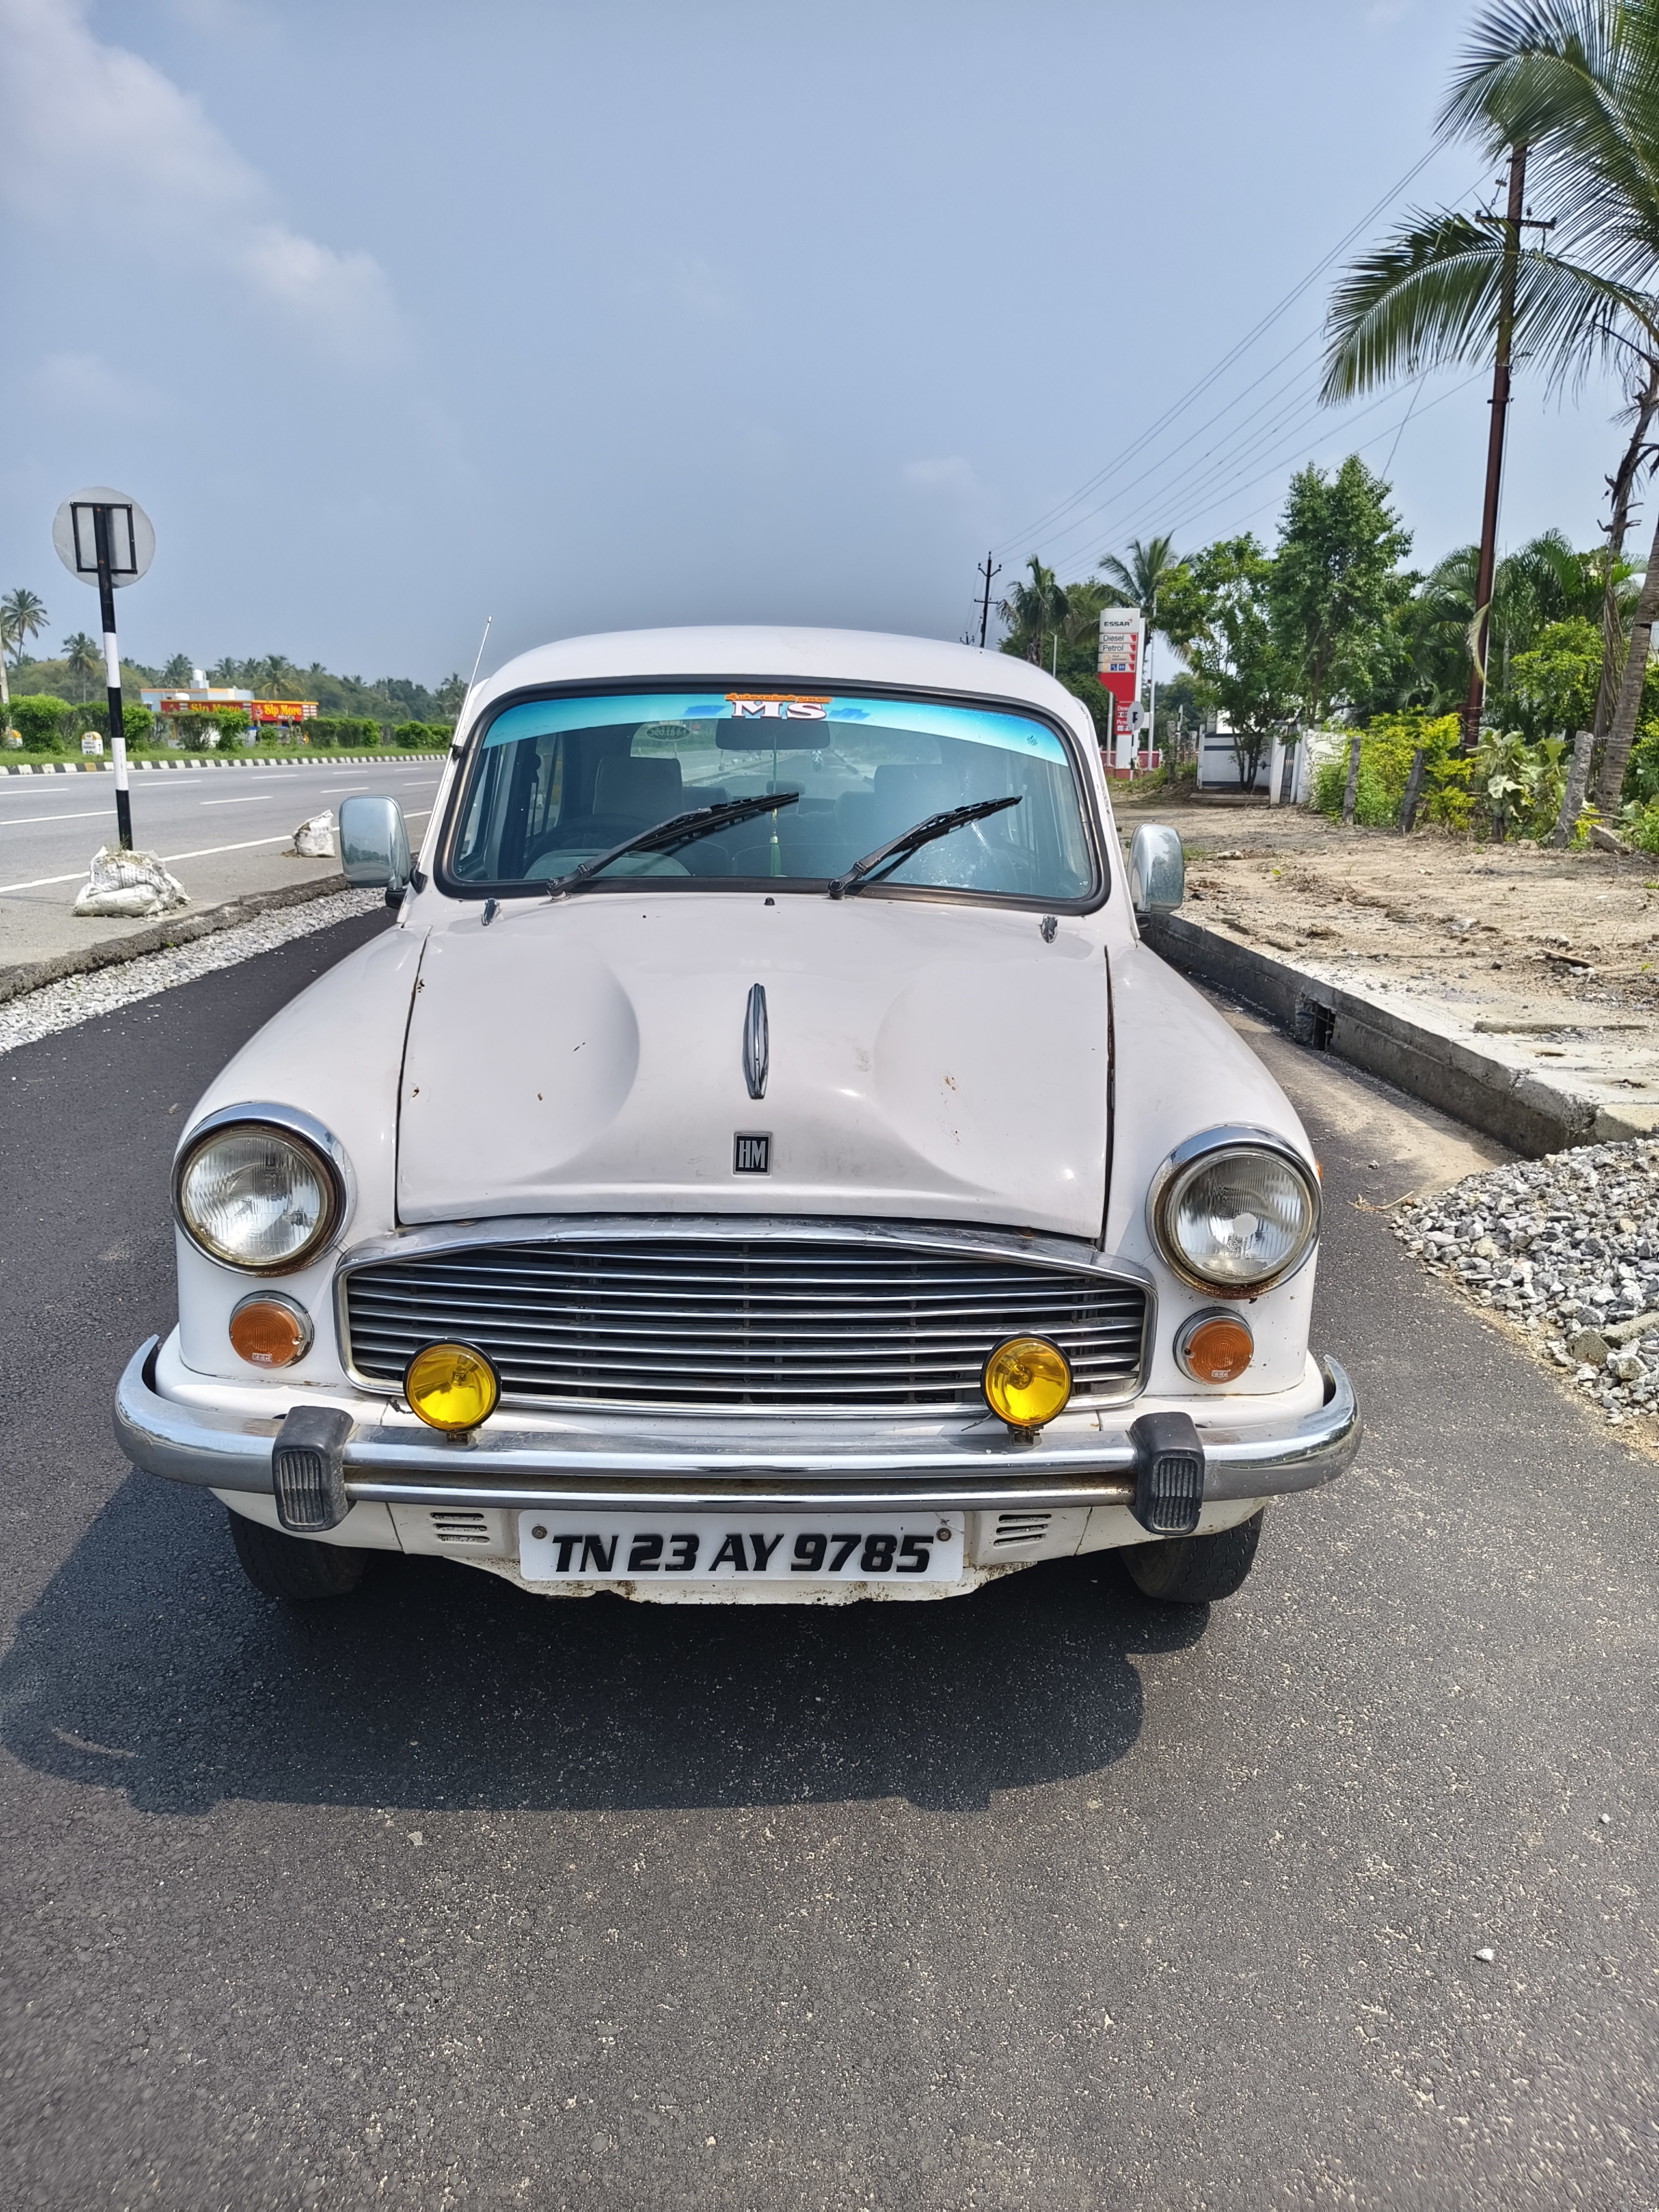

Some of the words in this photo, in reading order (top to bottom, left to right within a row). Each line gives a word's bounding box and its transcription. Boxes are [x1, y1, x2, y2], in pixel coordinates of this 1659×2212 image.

[264, 704, 279, 717] Sip
[280, 705, 302, 716] More
[731, 701, 827, 720] MS
[738, 1140, 766, 1168] HM
[552, 1534, 619, 1572] TN
[627, 1534, 699, 1572] 23
[709, 1534, 784, 1572] AY
[791, 1533, 934, 1573] 9785
